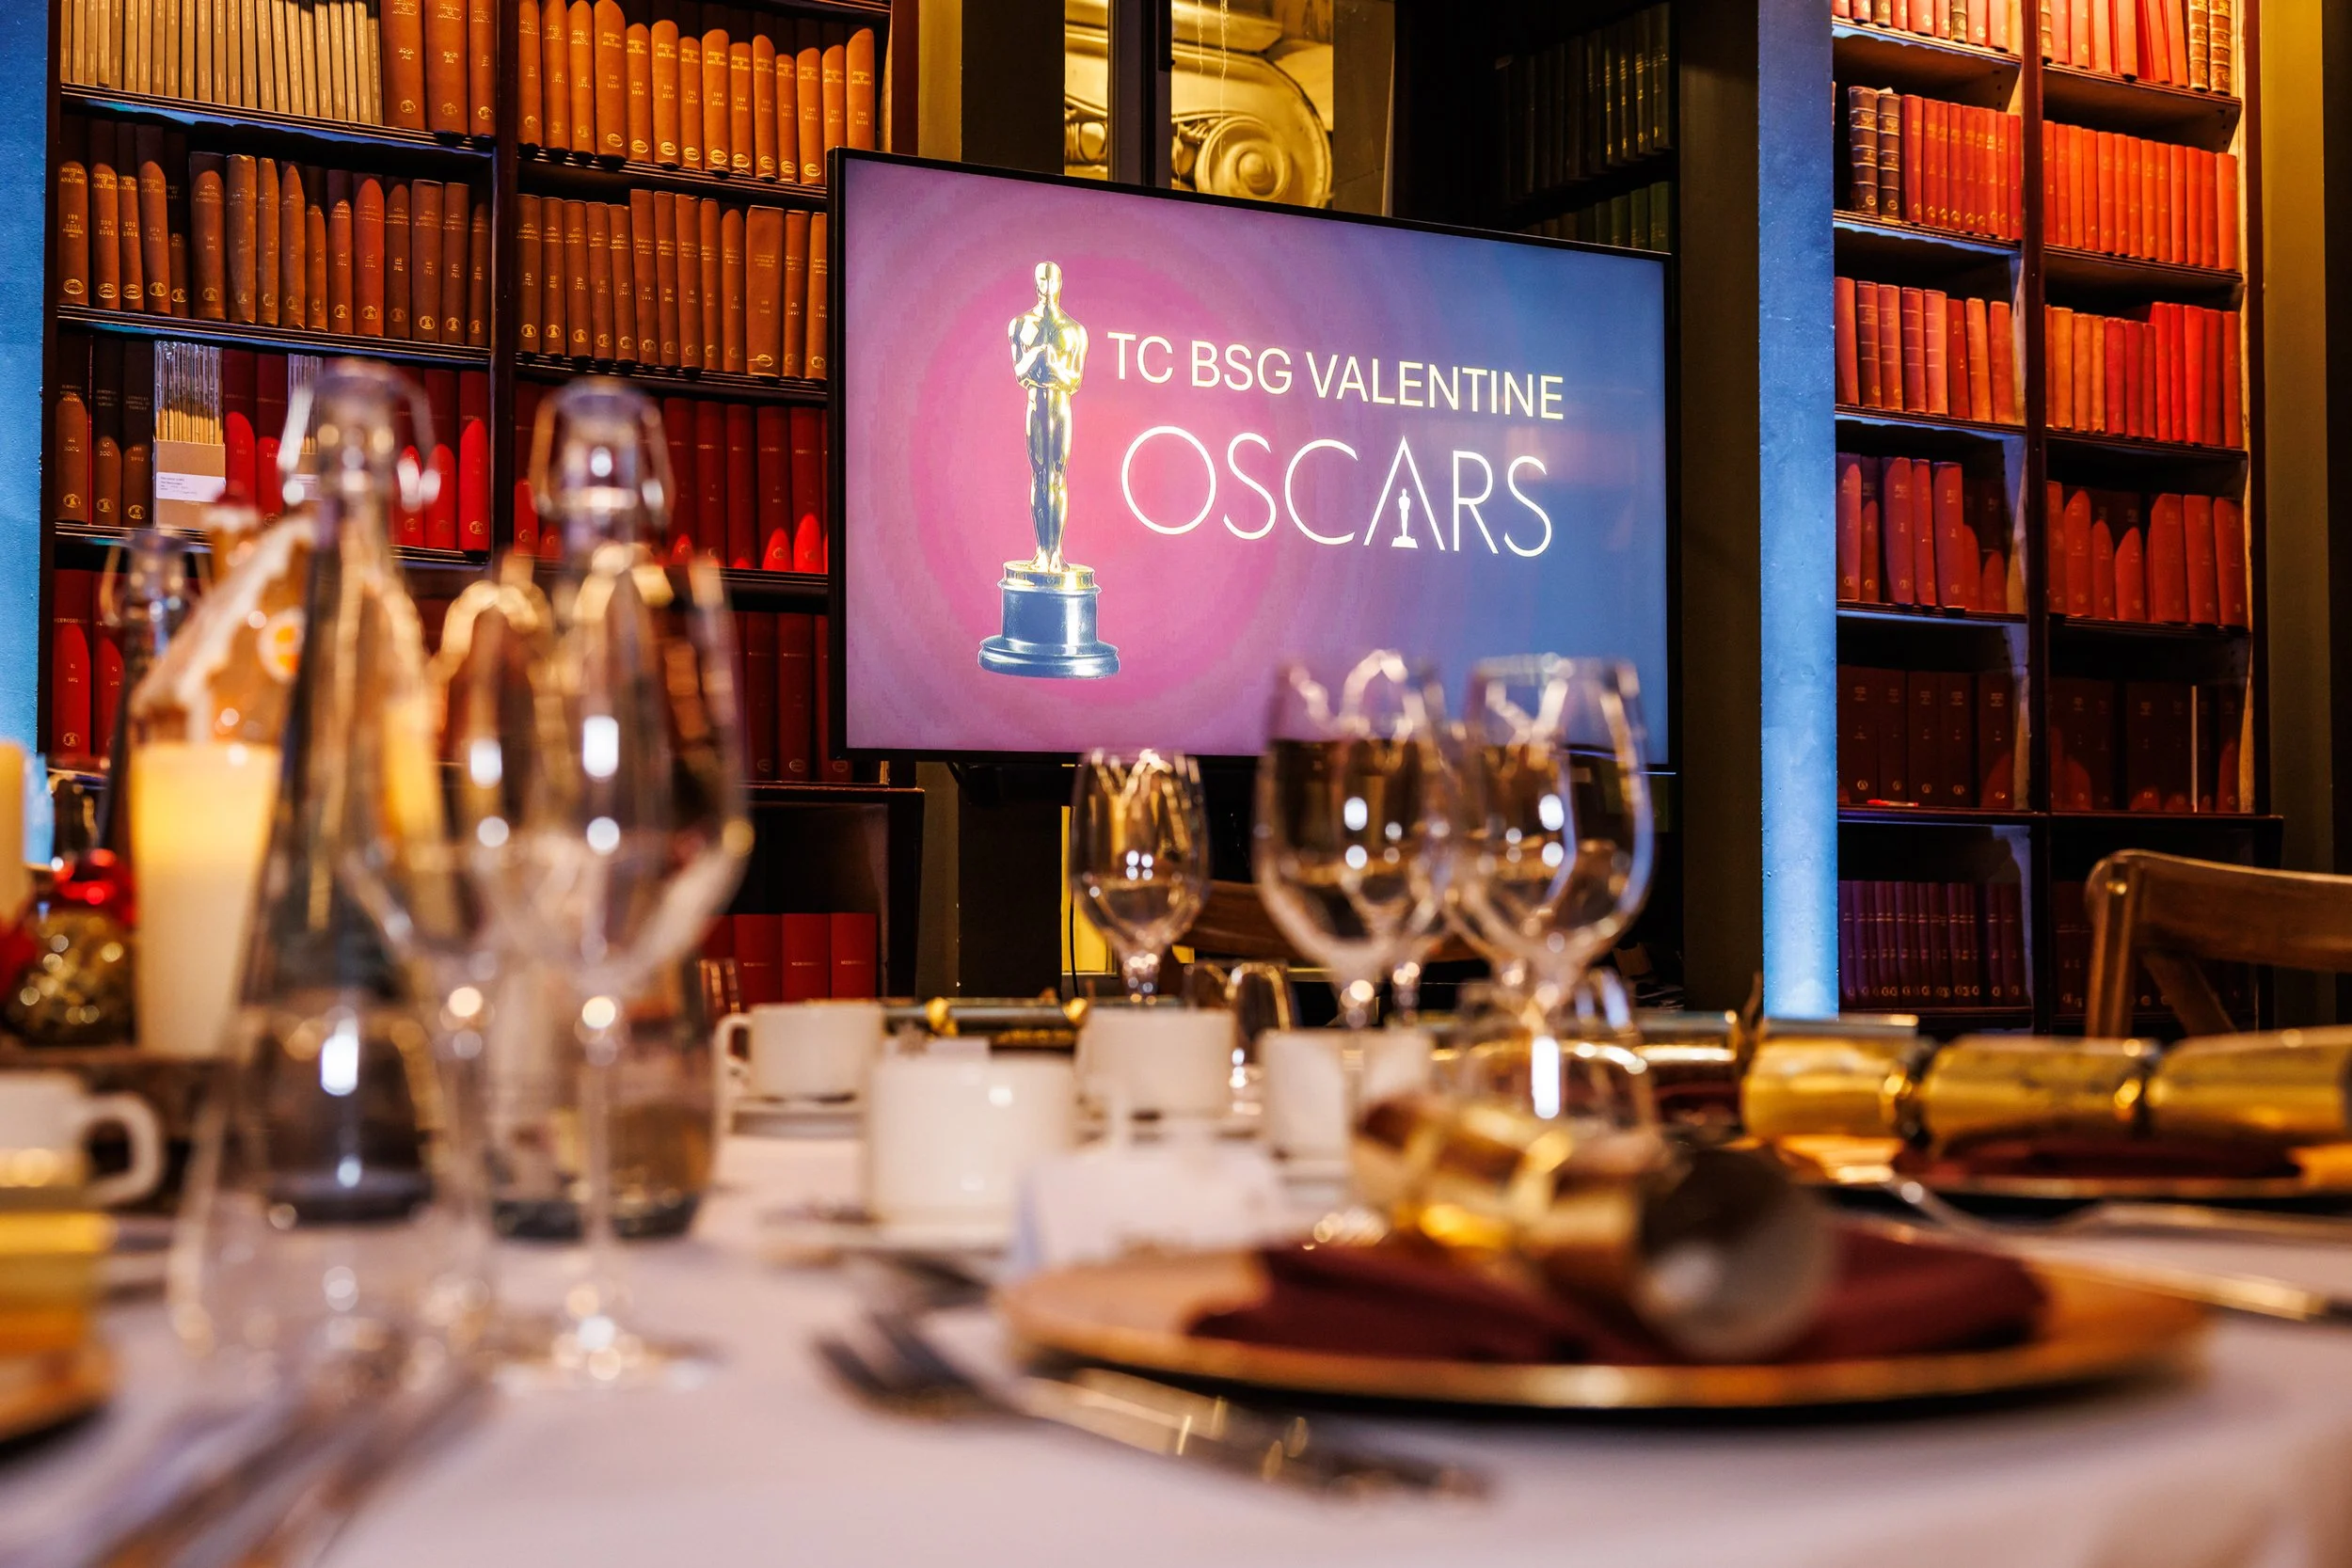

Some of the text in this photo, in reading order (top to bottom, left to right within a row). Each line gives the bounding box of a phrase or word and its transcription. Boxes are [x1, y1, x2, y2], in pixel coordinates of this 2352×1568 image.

[1106, 331, 1564, 420] TC BSG VALENTINE
[1120, 425, 1552, 558] OSCARS
